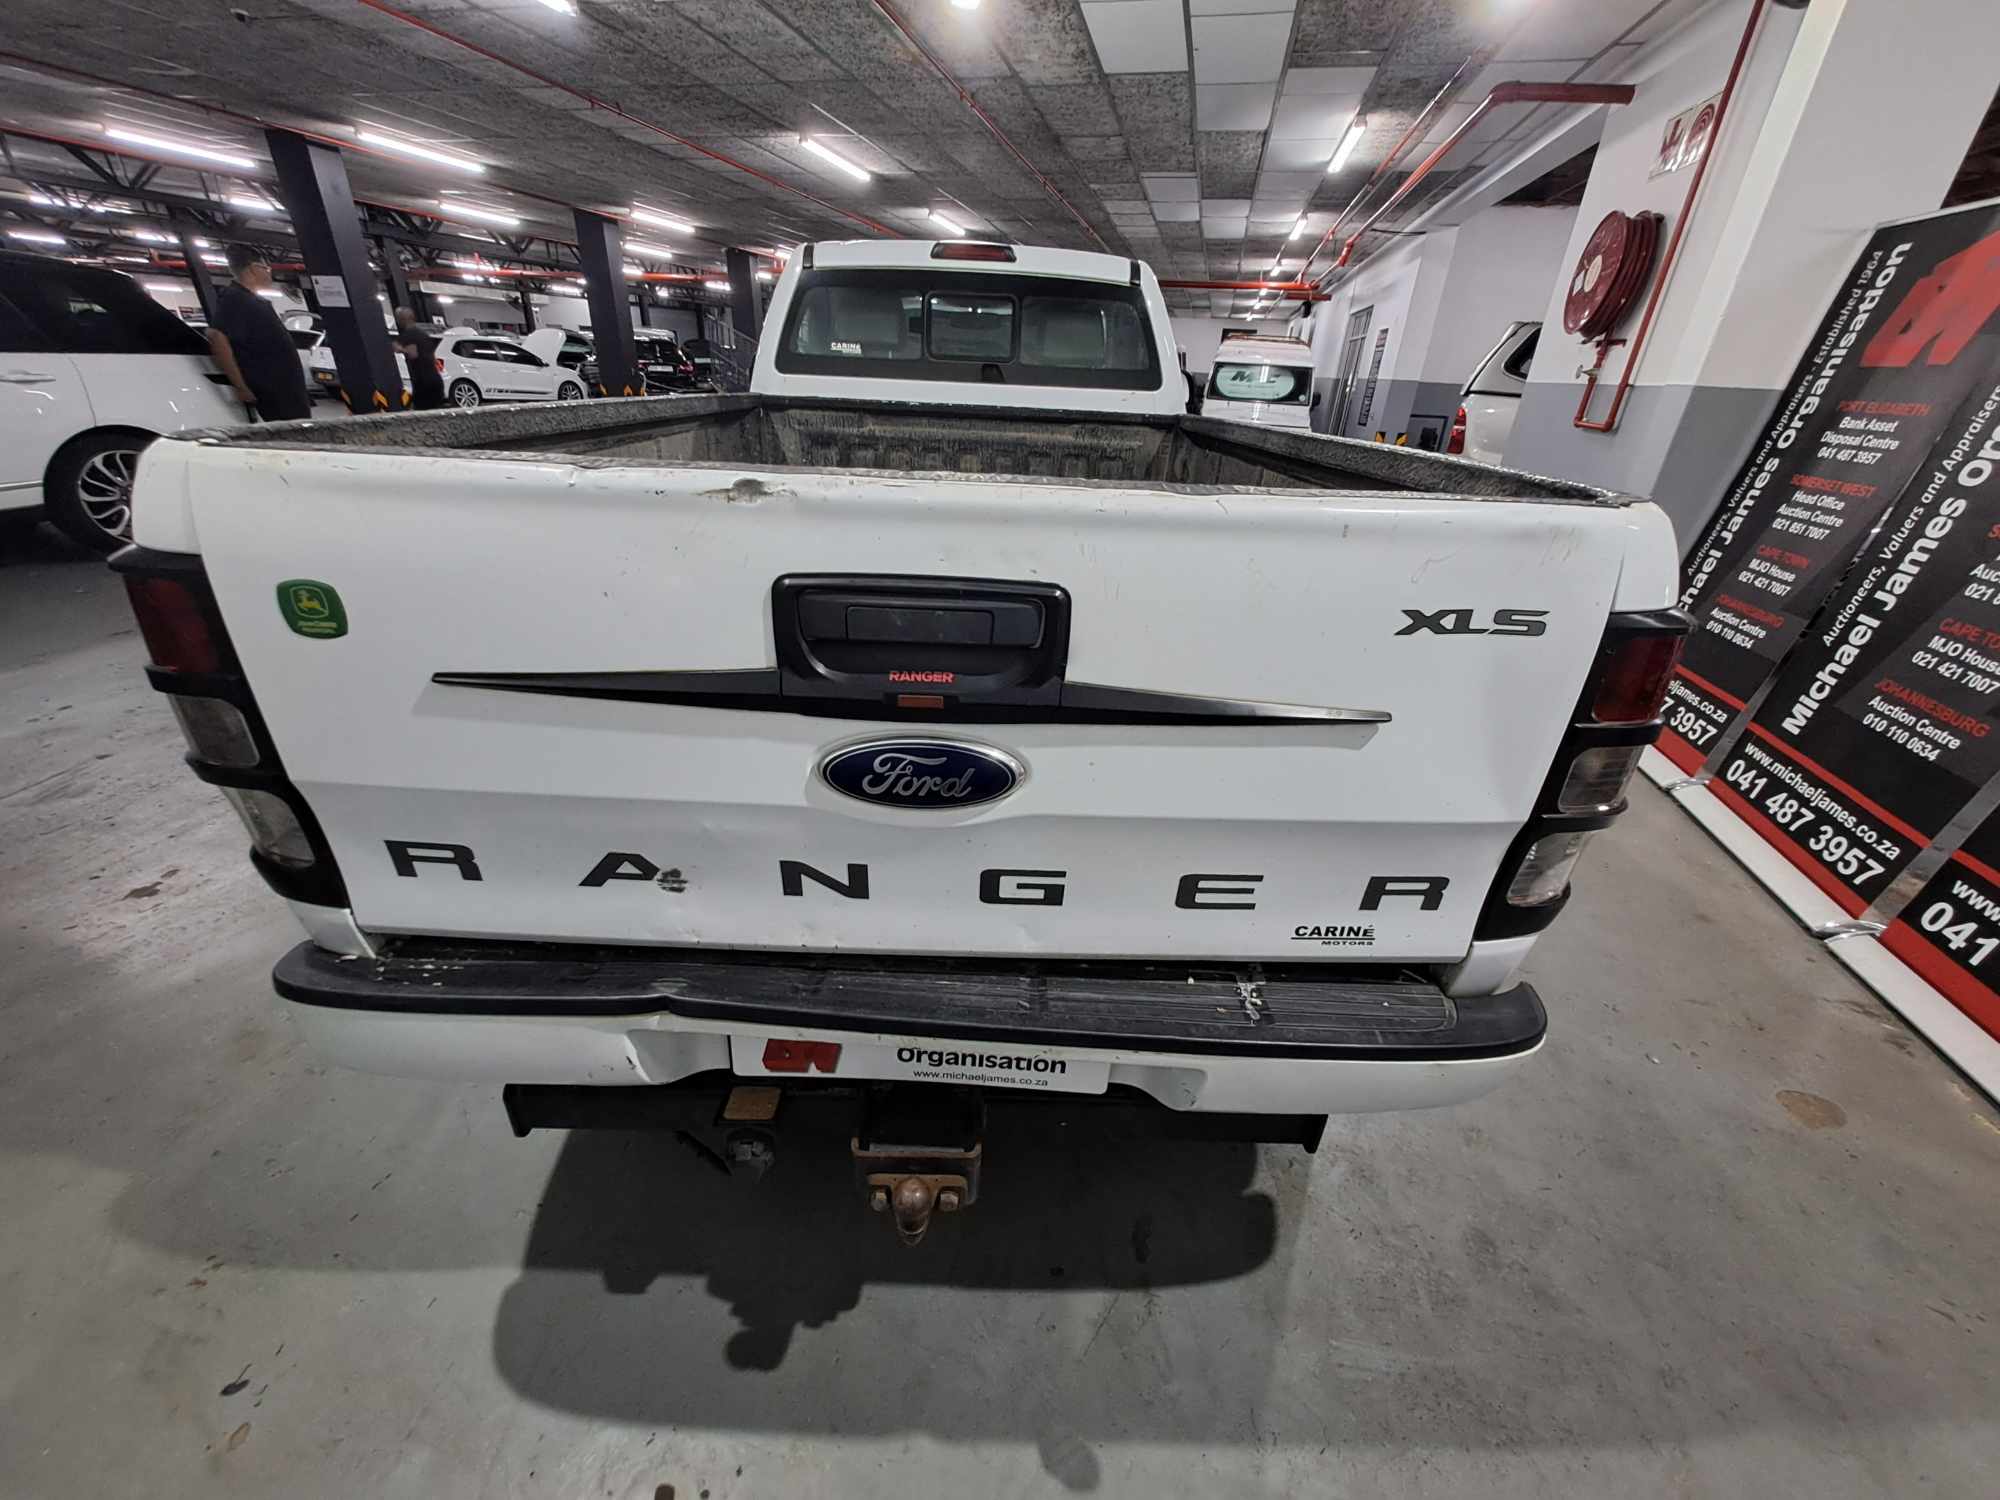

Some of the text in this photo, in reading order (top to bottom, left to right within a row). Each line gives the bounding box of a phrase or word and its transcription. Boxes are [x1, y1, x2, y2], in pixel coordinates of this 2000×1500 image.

[1720, 457, 1780, 545] James
[1777, 242, 1913, 449] Organisation
[1728, 466, 1758, 508] Valuers
[1756, 440, 1773, 464] and
[1771, 373, 1812, 440] Appraisers
[1813, 288, 1862, 364] Established
[1858, 250, 1883, 285] 1964
[1839, 417, 1899, 432] Bank Asset
[1821, 431, 1900, 450] Disposal Centre
[1817, 447, 1837, 459] 041
[1853, 451, 1883, 464] 3957
[1776, 503, 1844, 527] Auction Centre
[1792, 491, 1845, 510] Head Office
[1772, 518, 1830, 540] 021 851 7007
[1748, 558, 1796, 582] MJO House
[1822, 565, 1887, 647] Auctioneers,
[1880, 505, 1924, 560] Valuers
[1921, 472, 1948, 504] and
[1767, 581, 1791, 597] 7007
[1964, 582, 1995, 601] 021
[1393, 609, 1550, 636] XLS
[1710, 607, 1767, 639] Auction Centre
[1781, 614, 1882, 735] Michael
[1874, 497, 1967, 611] James
[1939, 618, 1983, 641] CAPE
[1928, 635, 1964, 657] MJO
[889, 671, 955, 683] RANGER
[1911, 651, 2000, 694] 021 421 7007
[1867, 695, 1961, 750] Auction Centre
[1874, 678, 1991, 738] JOHANNESBURG
[1670, 706, 1719, 745] 3957
[1862, 712, 1941, 762] 010 110 0634
[862, 752, 975, 798] Ford
[1744, 742, 1901, 861] www.michaeljames.co.za
[1724, 759, 1886, 886] 041 487 3957
[384, 839, 1450, 912] RANGER
[1921, 902, 2000, 966] 041
[897, 1047, 1067, 1074] Organisation
[913, 1070, 1049, 1087] www.michaeljames.co.za
